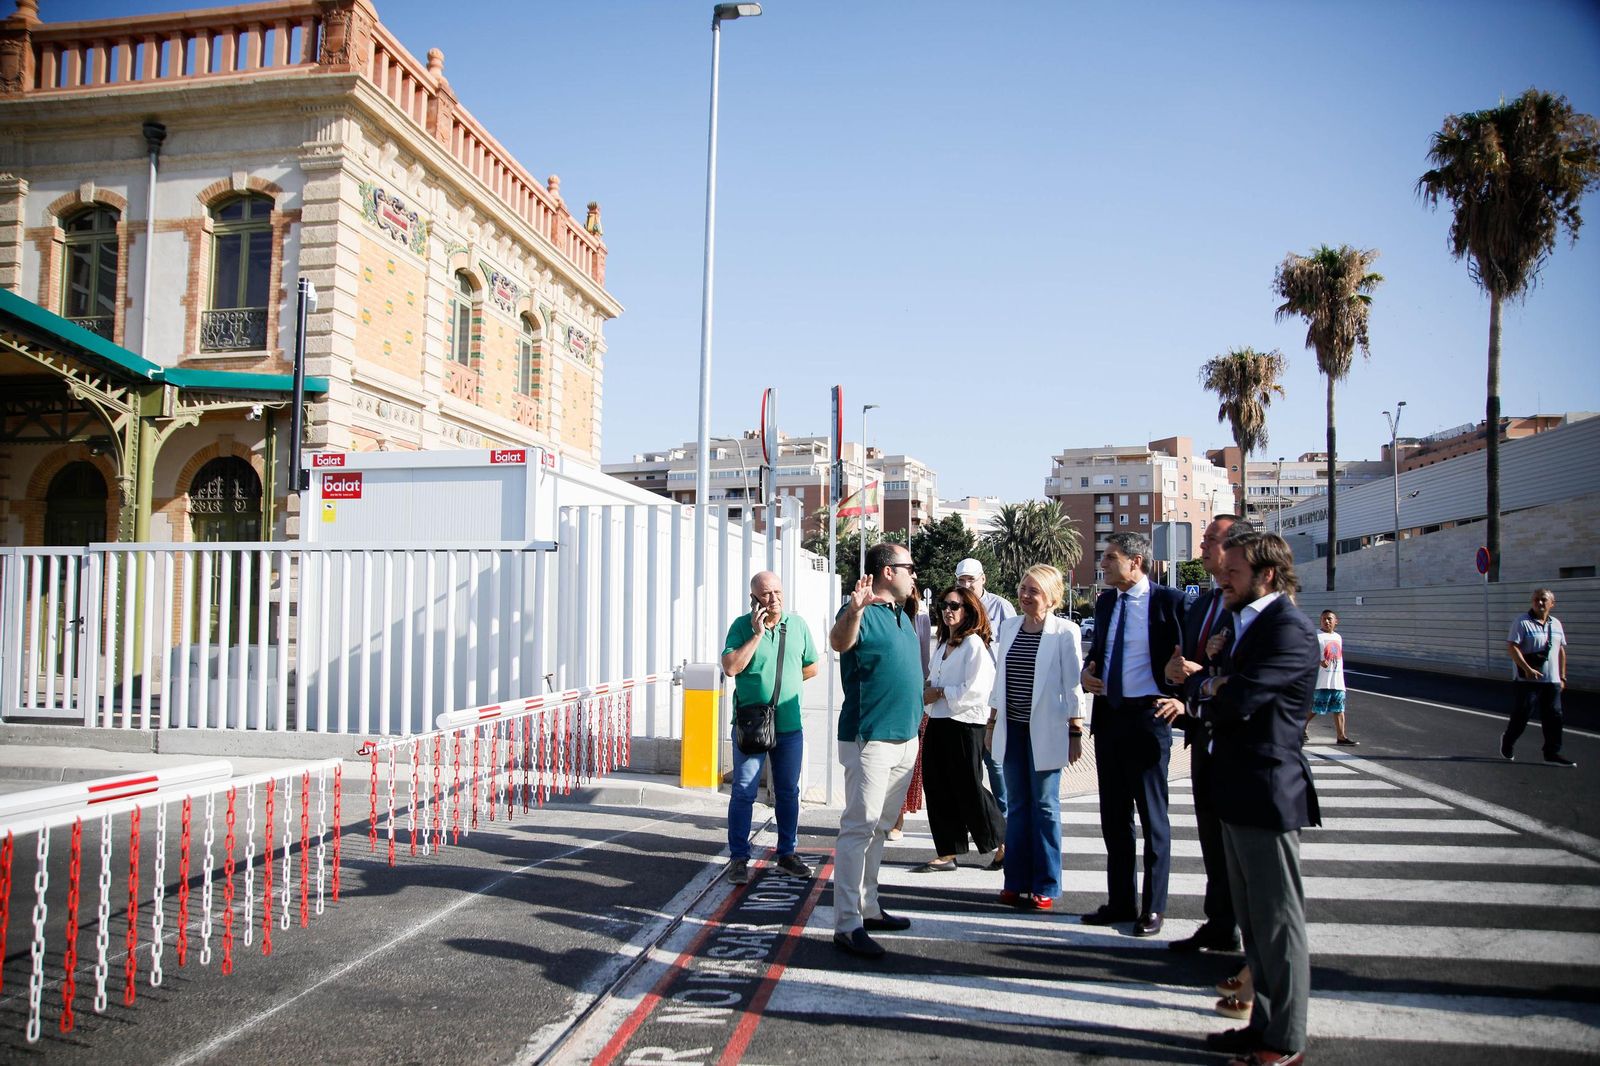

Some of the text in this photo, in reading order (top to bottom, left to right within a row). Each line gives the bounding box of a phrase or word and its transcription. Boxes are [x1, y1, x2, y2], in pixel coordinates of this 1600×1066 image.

[317, 454, 341, 465] balat
[495, 451, 521, 462] balat
[324, 475, 361, 492] balat
[739, 891, 800, 912] NO
[686, 922, 783, 983] PASAR
[656, 989, 742, 1025] NO
